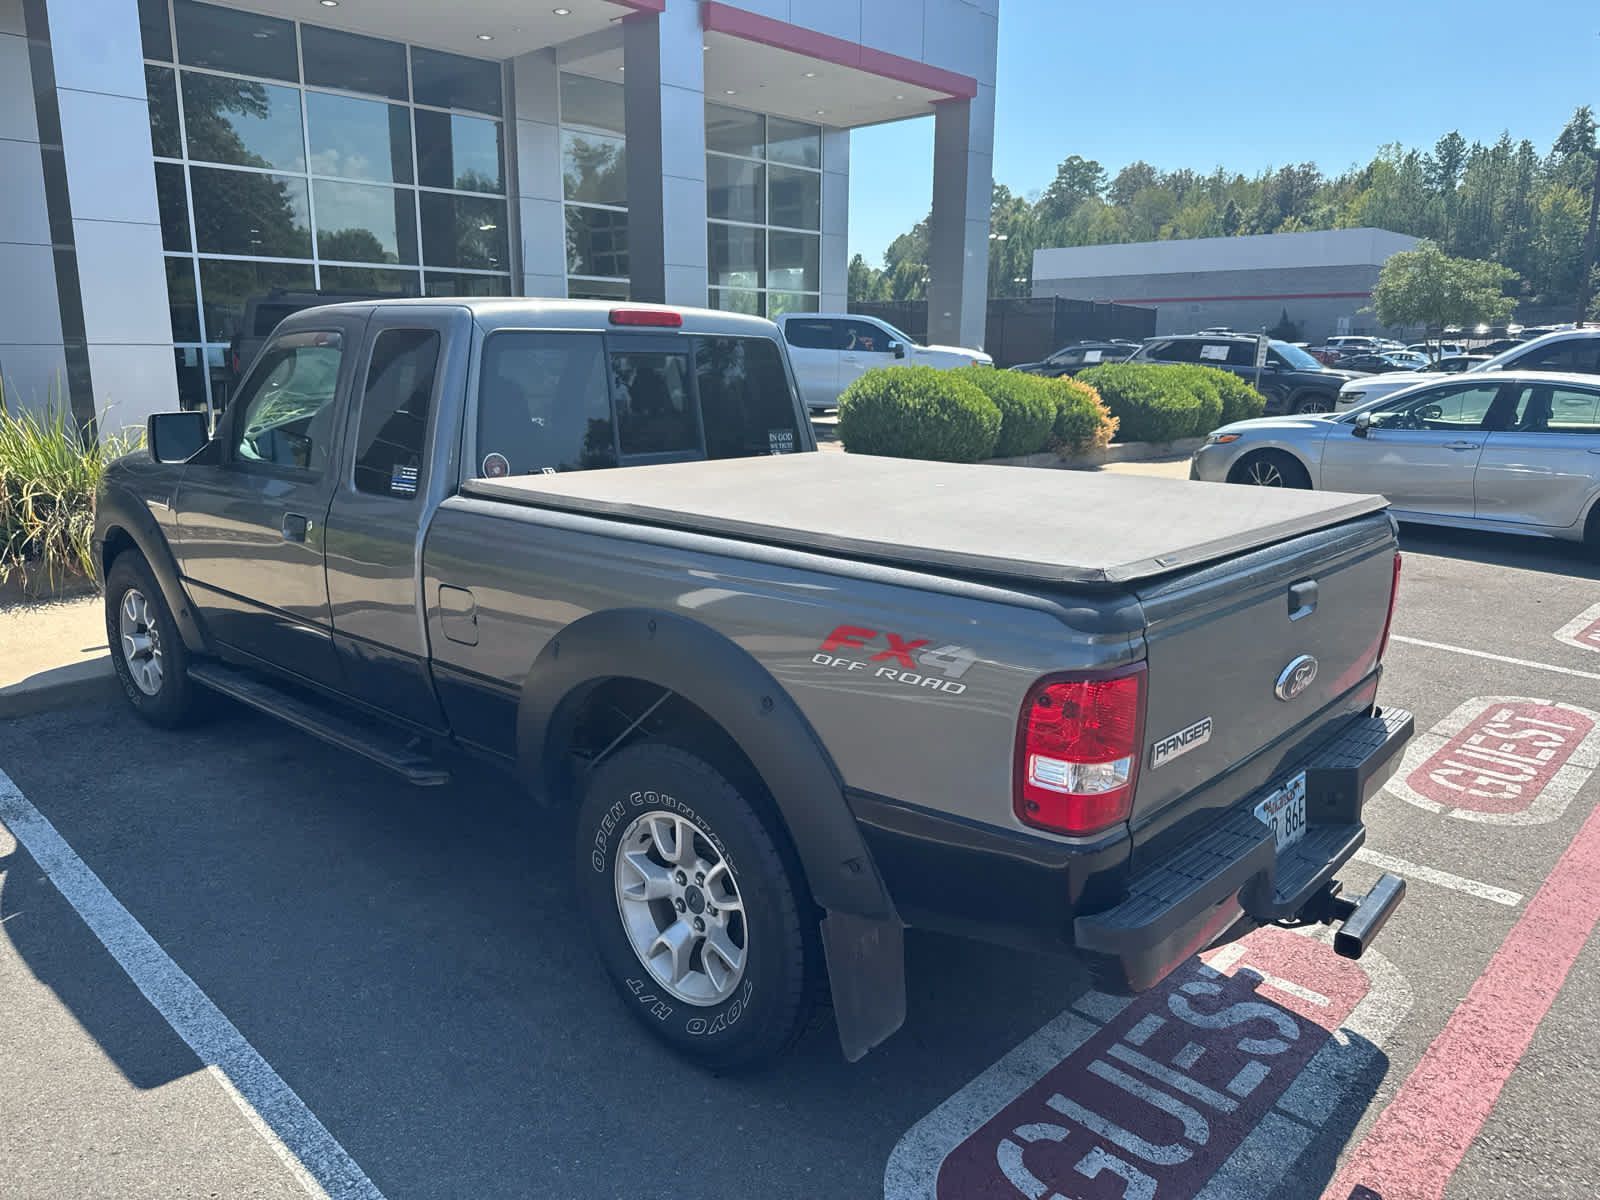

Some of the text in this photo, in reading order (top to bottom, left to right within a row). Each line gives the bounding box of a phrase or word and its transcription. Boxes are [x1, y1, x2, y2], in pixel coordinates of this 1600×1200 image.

[811, 653, 967, 695] OFF ROAD
[819, 624, 977, 678] FX4
[1154, 719, 1212, 761] RANGER
[1429, 708, 1576, 799] GUEST
[592, 791, 738, 875] OPEN COUNTRY
[1285, 794, 1305, 837] 86E
[626, 976, 753, 1035] TOYO H/T
[996, 943, 1331, 1200] GUEST
